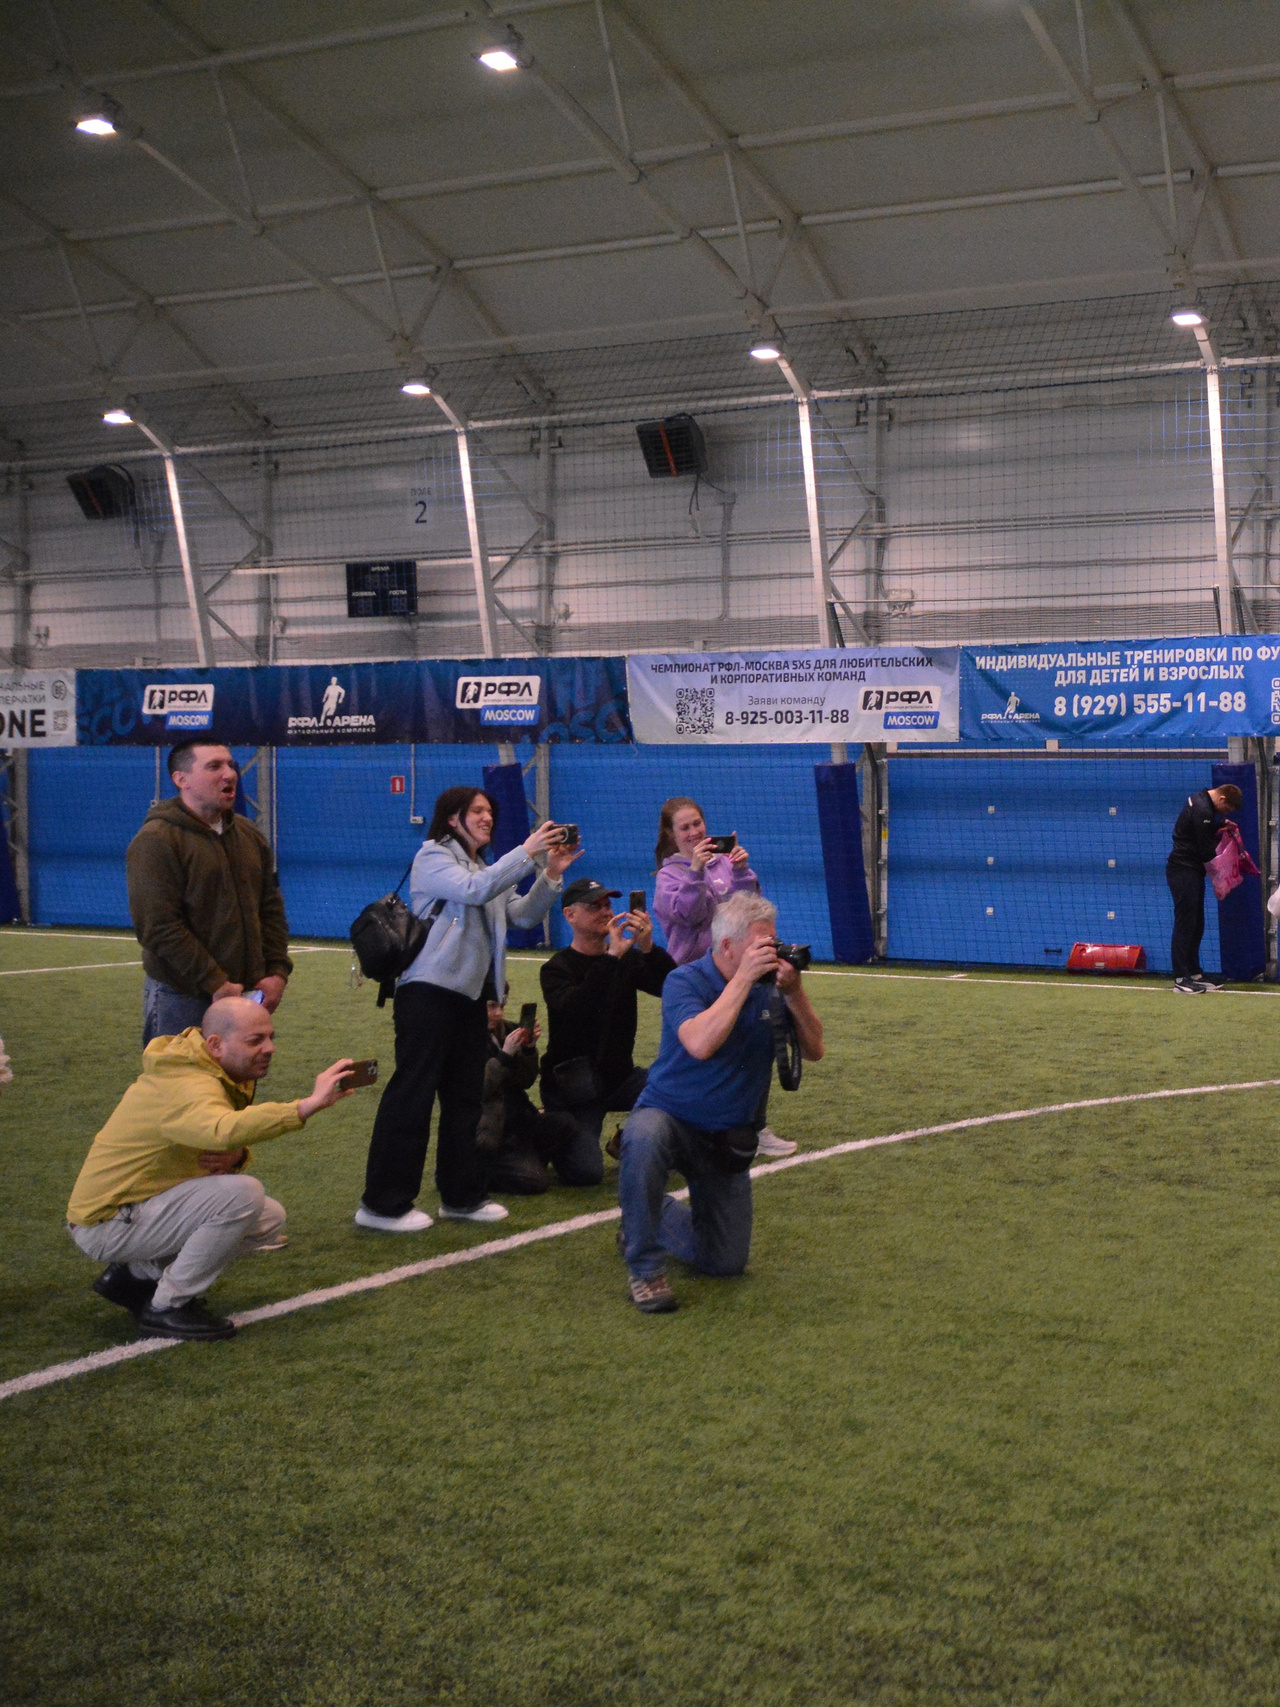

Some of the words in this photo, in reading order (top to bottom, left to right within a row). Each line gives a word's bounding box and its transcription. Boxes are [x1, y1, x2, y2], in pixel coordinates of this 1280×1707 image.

[415, 501, 427, 523] 2
[651, 662, 716, 674] ЧЕМПИОНАТ
[718, 660, 790, 672] РФЛ-МОСКВА
[814, 658, 837, 670] ДЛЯ
[839, 656, 933, 669] ЛЮБИТЕЛЬСКИХ
[975, 652, 1121, 671] ИНДИВИДУАЛЬНЫЕ
[1125, 647, 1228, 665] ТРЕНИРОВКИ
[1232, 647, 1253, 662] ПО
[710, 674, 718, 684] И
[720, 672, 814, 684] КОРПОРАТИВНЫХ
[817, 670, 866, 682] КОМАНД
[1054, 670, 1087, 687] ДЛЯ
[1089, 665, 1139, 686] ДЕТЕЙ
[1143, 667, 1155, 682] И
[1158, 665, 1245, 681] ВЗРОСЛЫХ
[0, 680, 45, 692] АЛЬНЫЕ
[484, 682, 533, 697] РФЛ
[168, 690, 208, 704] РФЛ
[748, 696, 778, 705] Заяви
[780, 696, 826, 706] команду
[886, 690, 933, 704] РФЛ
[1054, 696, 1067, 716] 8
[1072, 692, 1127, 718] (929)
[1133, 691, 1247, 714] 555-11-88
[168, 714, 210, 726] MOSCOW
[288, 716, 318, 728] РФЛ
[332, 715, 376, 727] АРЕНА
[484, 709, 535, 721] MOSCOW
[725, 709, 850, 725] 8-925-003-11-88
[887, 715, 935, 725] MOSCOW
